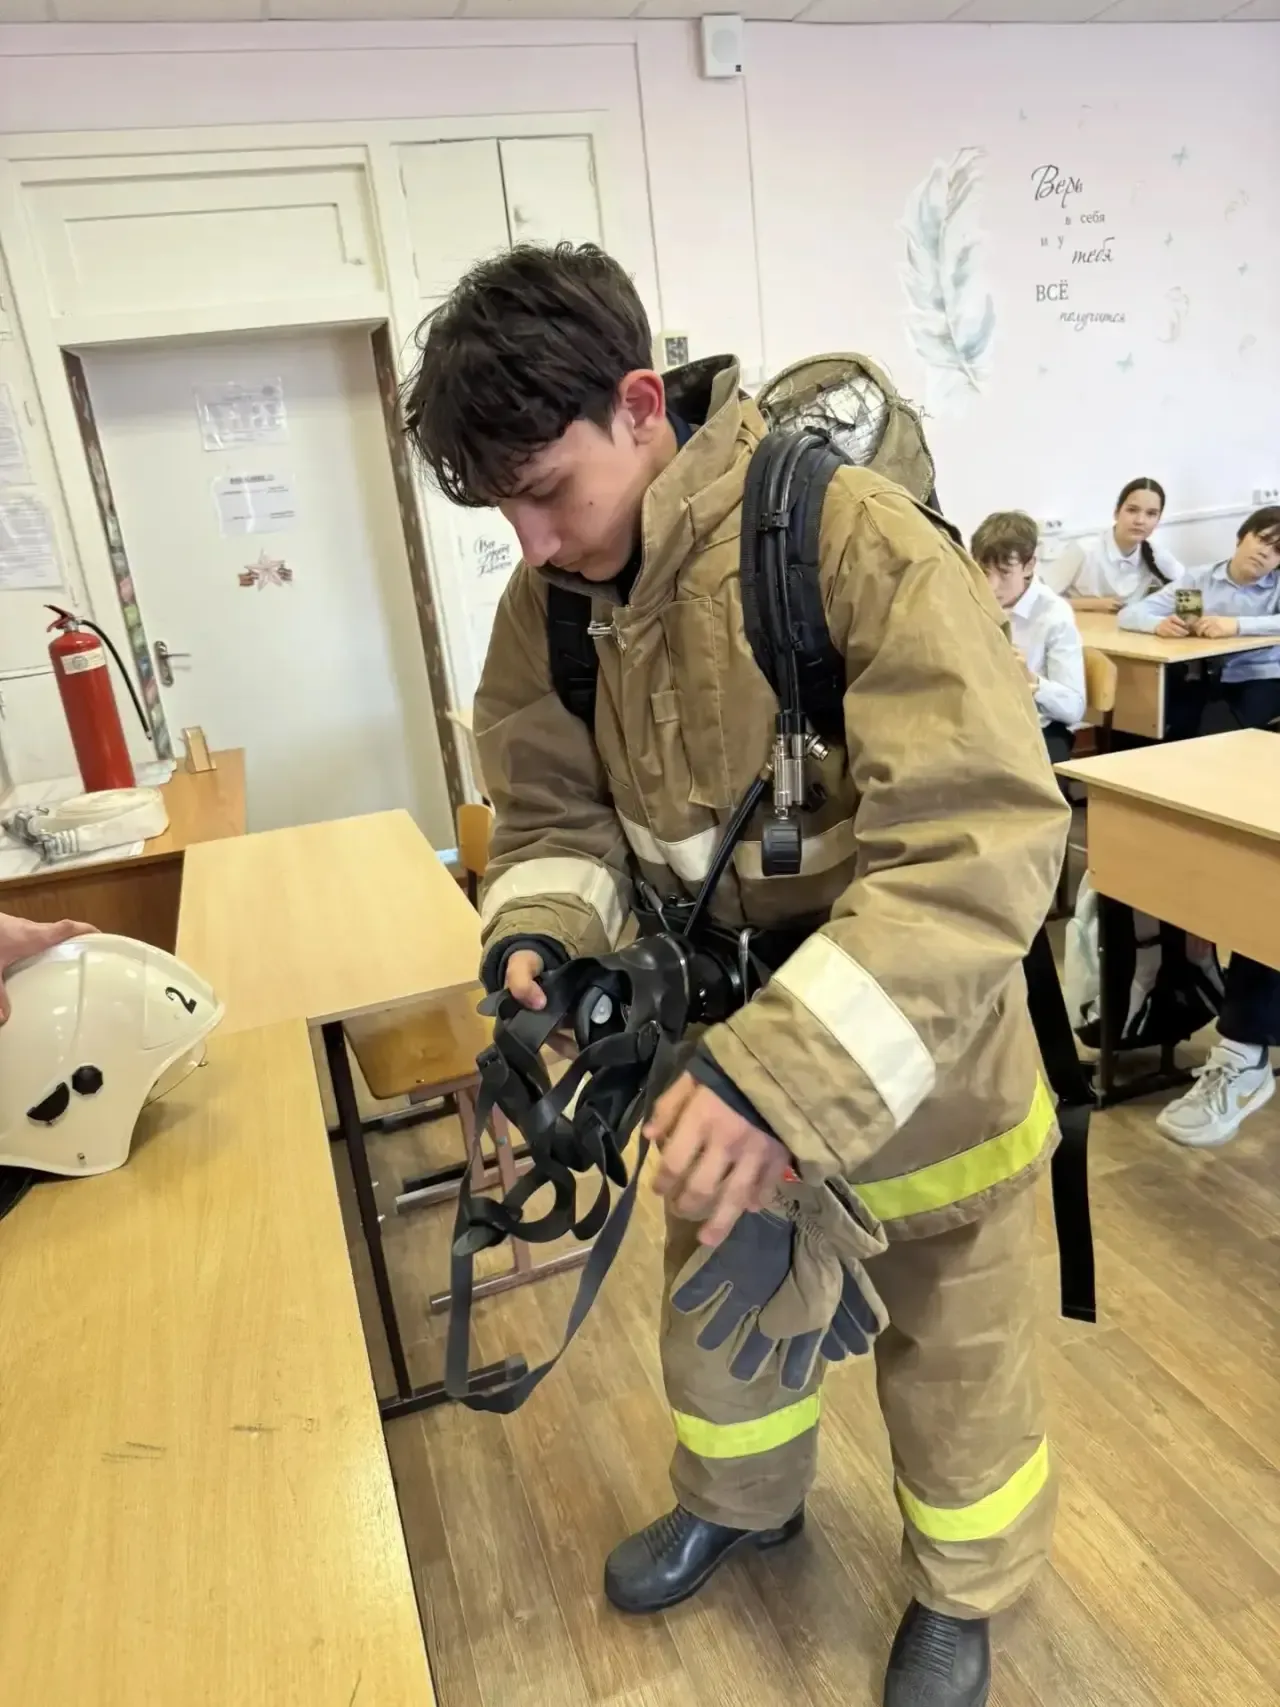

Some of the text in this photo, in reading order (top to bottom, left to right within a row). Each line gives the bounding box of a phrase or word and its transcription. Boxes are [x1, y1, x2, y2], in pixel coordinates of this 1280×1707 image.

[1030, 163, 1084, 209] Верь
[1064, 210, 1106, 226] в себя
[1040, 235, 1116, 265] и у тебя
[1035, 279, 1070, 303] ВСЁ
[1059, 311, 1126, 332] получится
[164, 986, 198, 1015] 2
